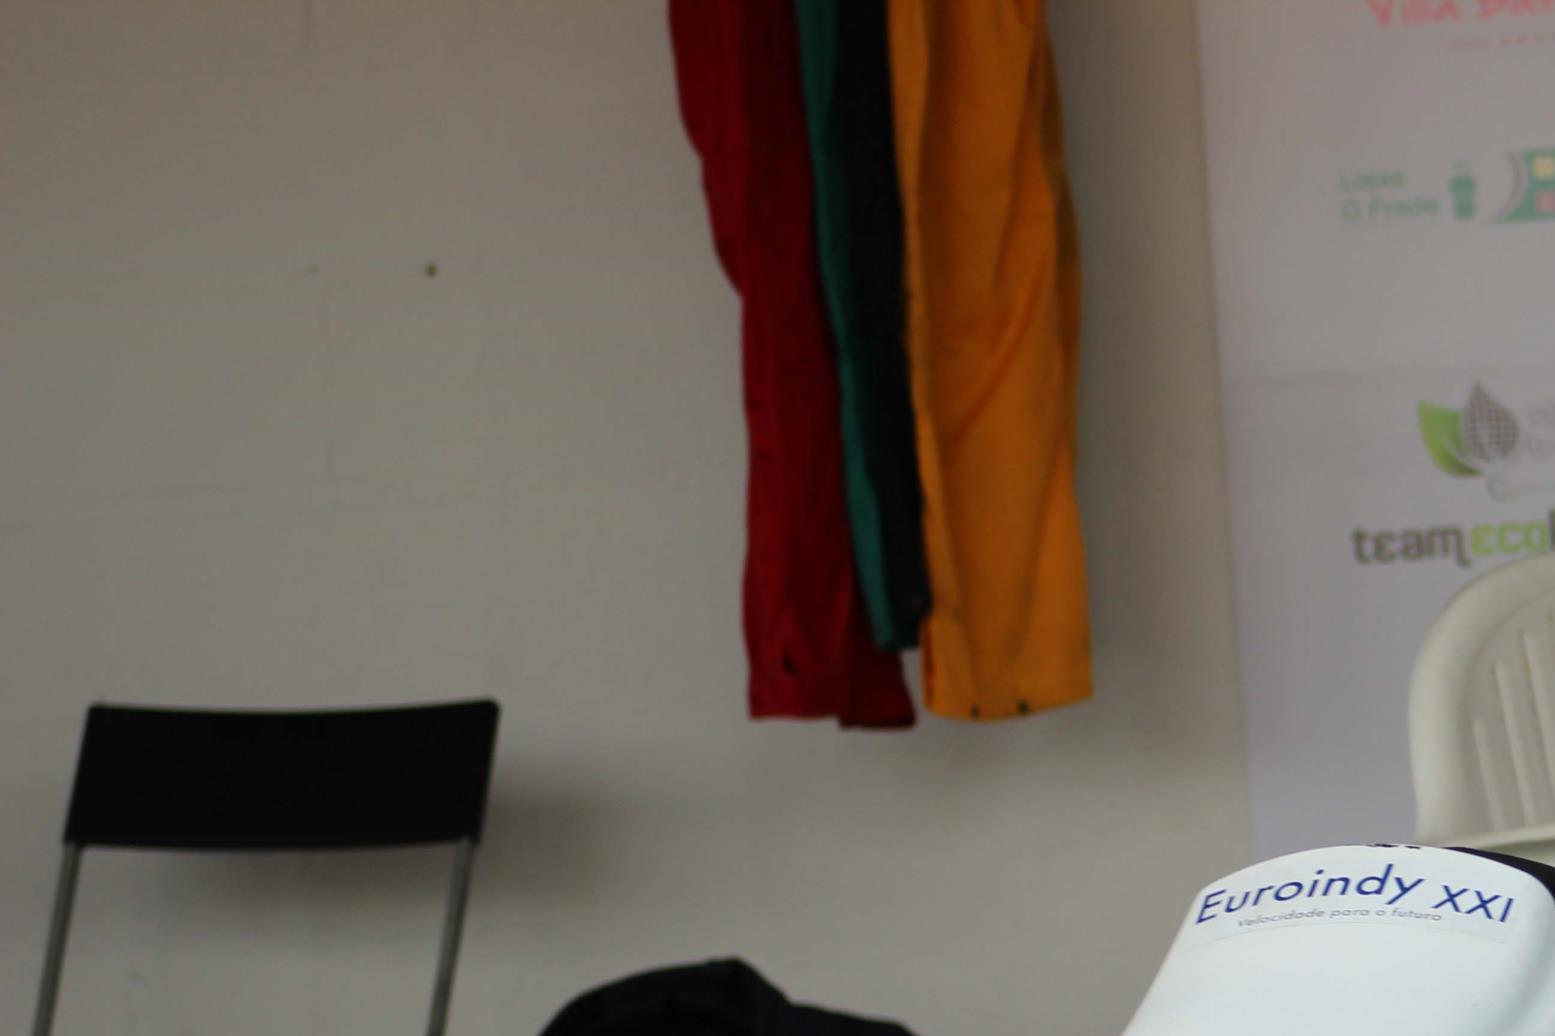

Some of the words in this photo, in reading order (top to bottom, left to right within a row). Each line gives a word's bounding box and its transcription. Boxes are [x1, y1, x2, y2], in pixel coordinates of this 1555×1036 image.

[1195, 864, 1424, 925] Euroindy
[1431, 884, 1515, 924] XXI
[1328, 907, 1371, 920] para
[1374, 908, 1387, 917] o
[1391, 907, 1444, 922] futuro
